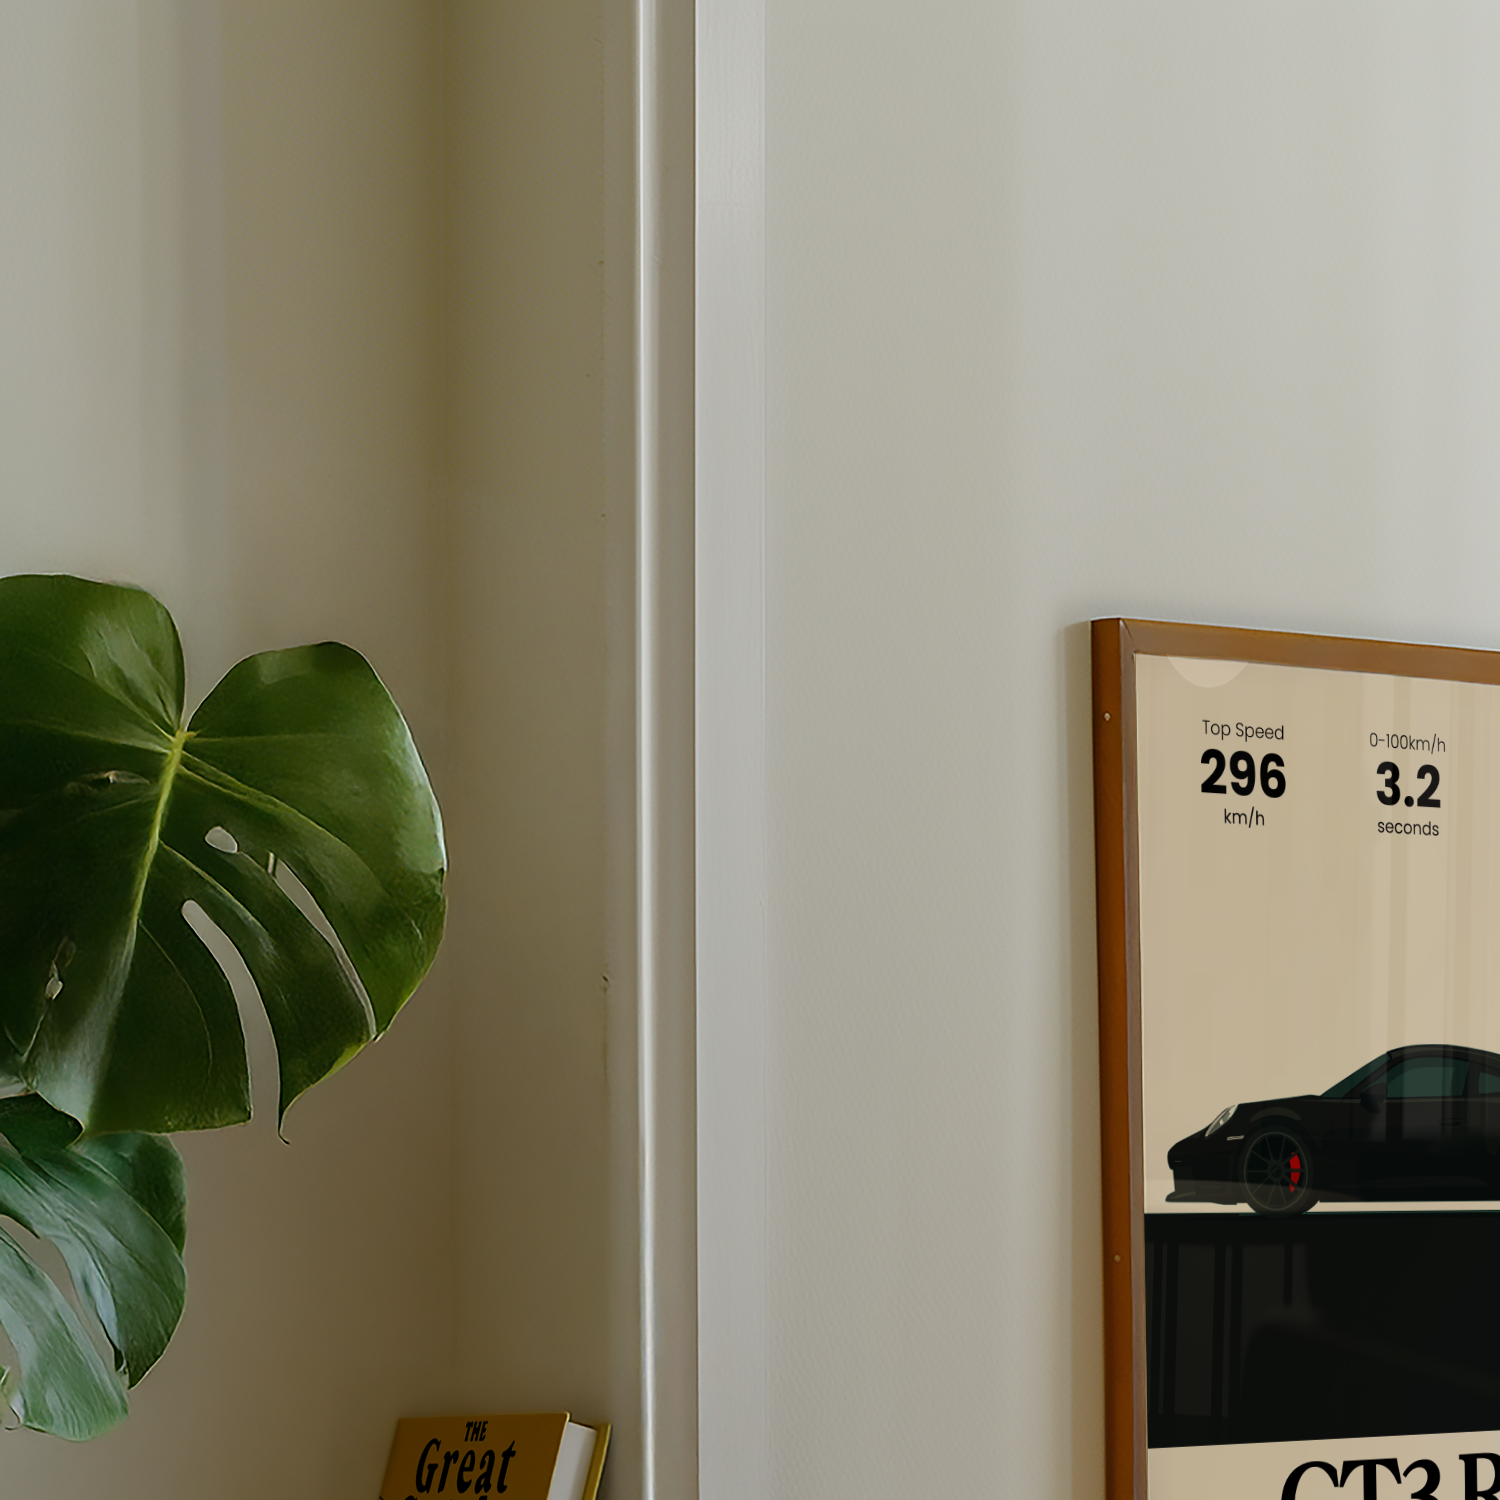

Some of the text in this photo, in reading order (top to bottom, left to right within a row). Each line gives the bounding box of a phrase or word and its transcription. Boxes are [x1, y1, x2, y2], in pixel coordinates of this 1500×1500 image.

[1202, 720, 1285, 742] Top Speed
[1369, 732, 1446, 754] 0-100km/h
[1200, 748, 1286, 798] 296
[1375, 761, 1441, 808] 3.2
[1223, 806, 1265, 828] km/h
[1377, 820, 1440, 837] seconds
[464, 1420, 489, 1442] THE
[415, 1437, 518, 1495] Great
